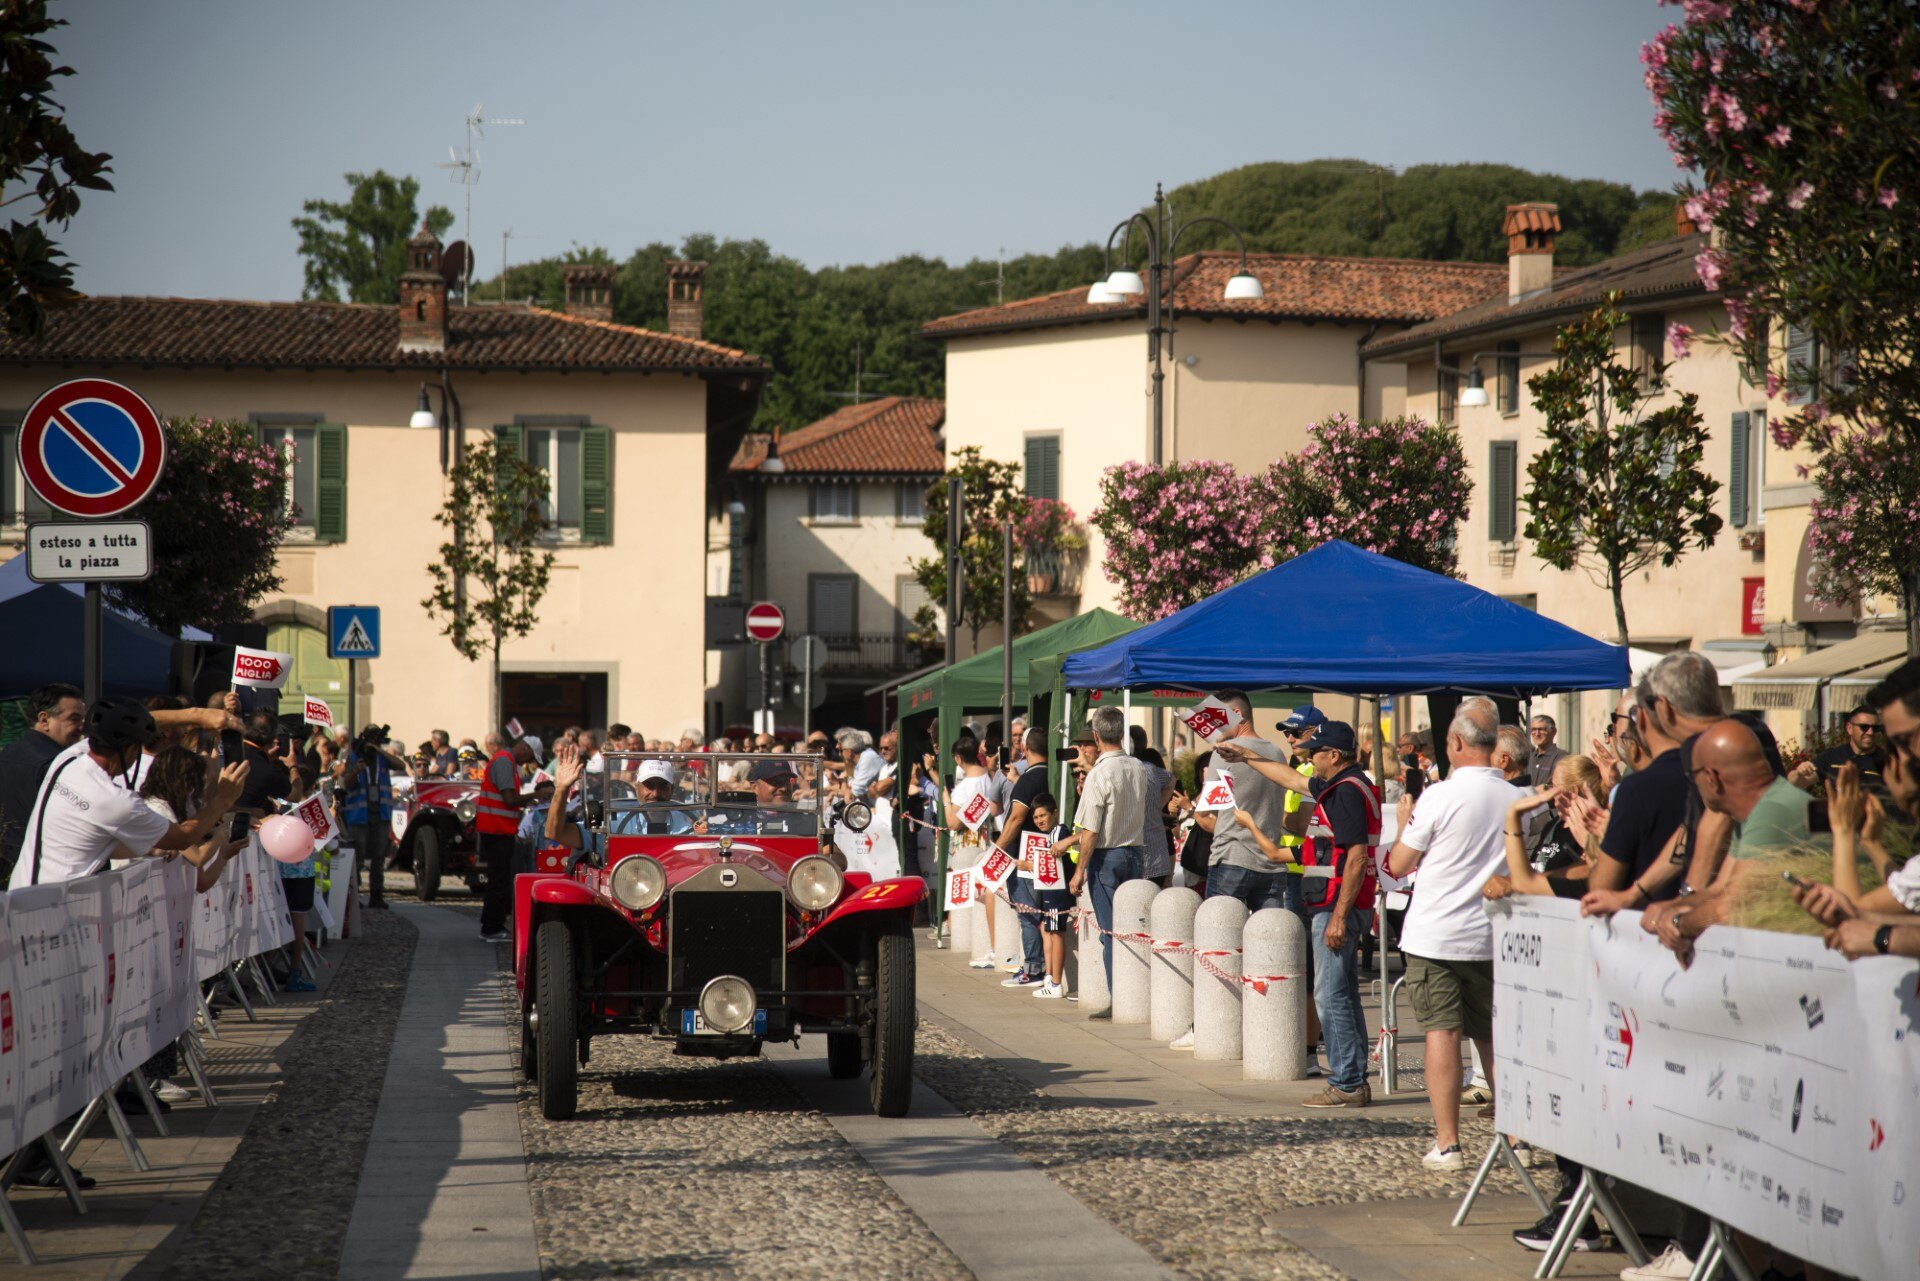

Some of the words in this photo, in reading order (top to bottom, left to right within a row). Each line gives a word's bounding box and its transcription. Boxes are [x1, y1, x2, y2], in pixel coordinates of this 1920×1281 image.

[40, 536, 81, 549] esteso
[88, 538, 96, 548] a
[103, 534, 138, 548] tutta
[59, 556, 72, 568] la
[80, 555, 120, 571] piazza
[240, 657, 271, 669] 1000
[236, 667, 272, 679] MIGLIA
[1188, 712, 1211, 728] 000
[1197, 718, 1224, 737] IGLIA
[967, 796, 982, 814] 1000
[972, 801, 990, 821] MIGLIA
[311, 803, 326, 827] 1000
[987, 850, 1002, 869] 1000
[861, 885, 898, 900] 27
[961, 873, 969, 899] MIGLIA
[1502, 931, 1542, 967] CHOPARD
